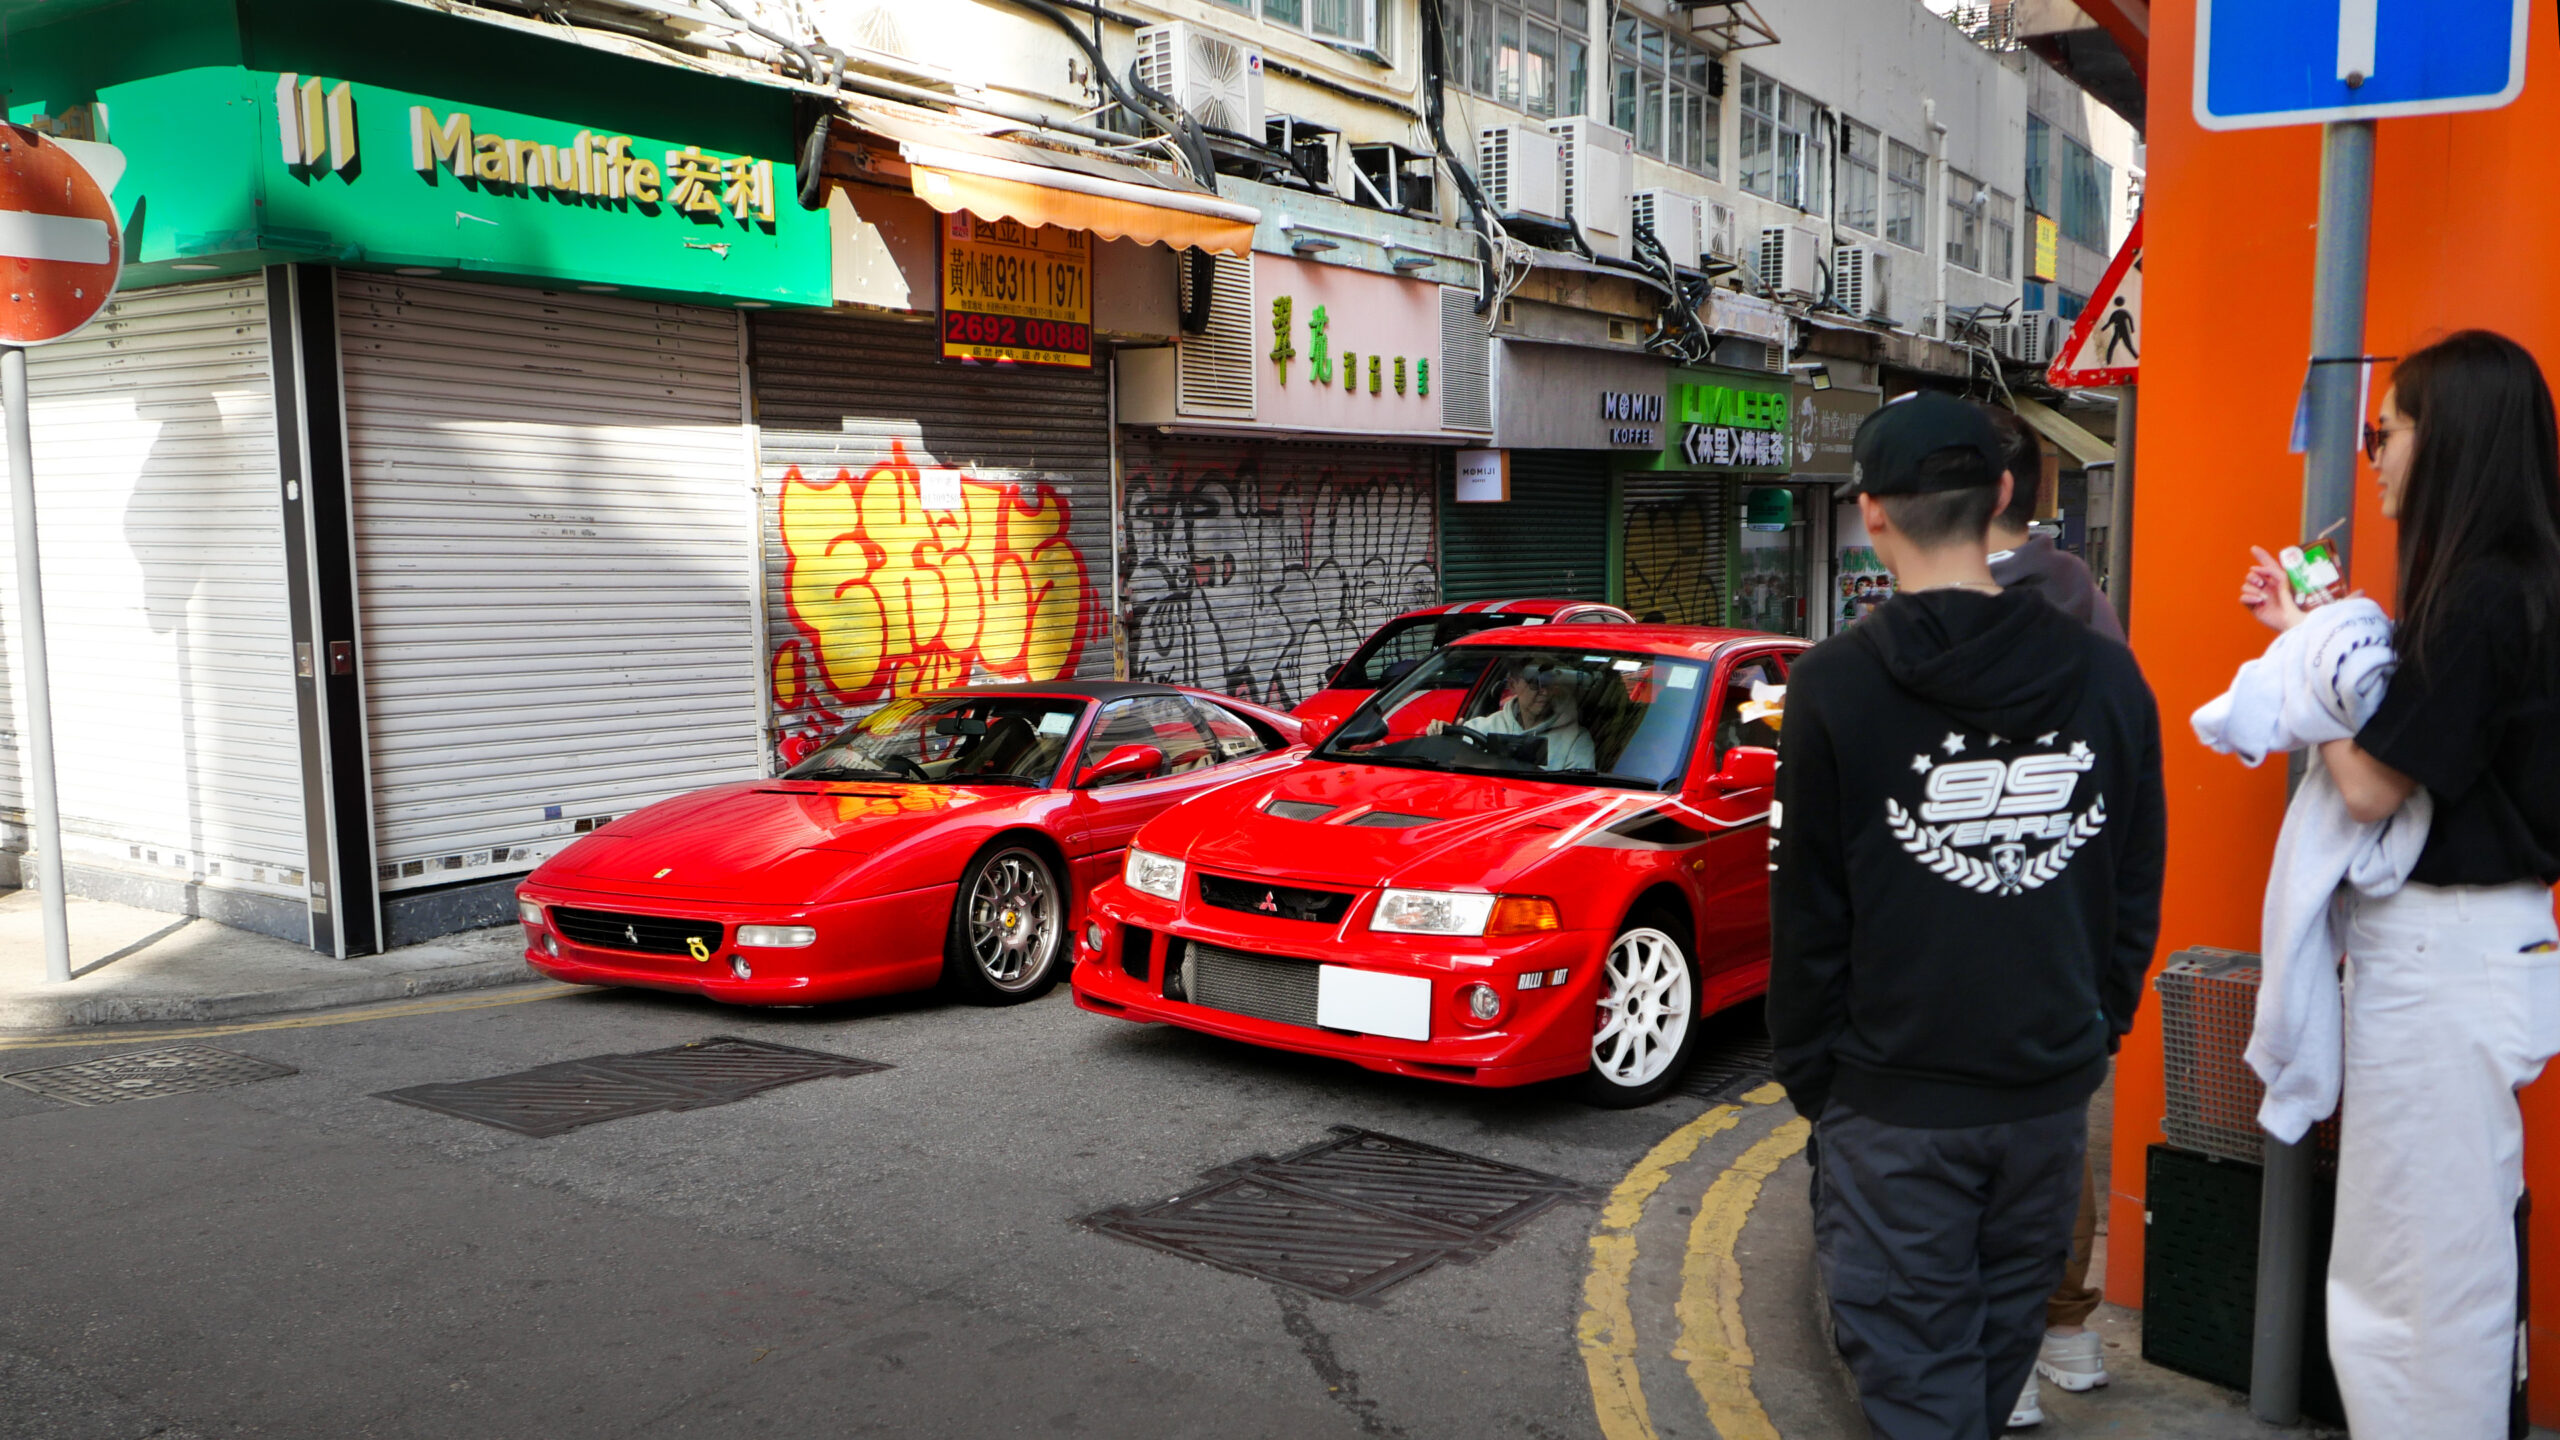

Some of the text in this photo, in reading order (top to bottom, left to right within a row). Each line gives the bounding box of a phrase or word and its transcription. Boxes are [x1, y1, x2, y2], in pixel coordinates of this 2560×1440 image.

[410, 105, 775, 222] Manulife 宏利
[996, 254, 1036, 303] 9311
[1047, 262, 1083, 309] 1971
[948, 313, 1086, 350] 2692 0088
[1603, 391, 1664, 423] MOMIJI
[1611, 428, 1654, 444] KOFFEE
[1463, 467, 1495, 476] MOMIJI
[1919, 753, 2095, 822] 95
[1925, 812, 2074, 848] YEARS
